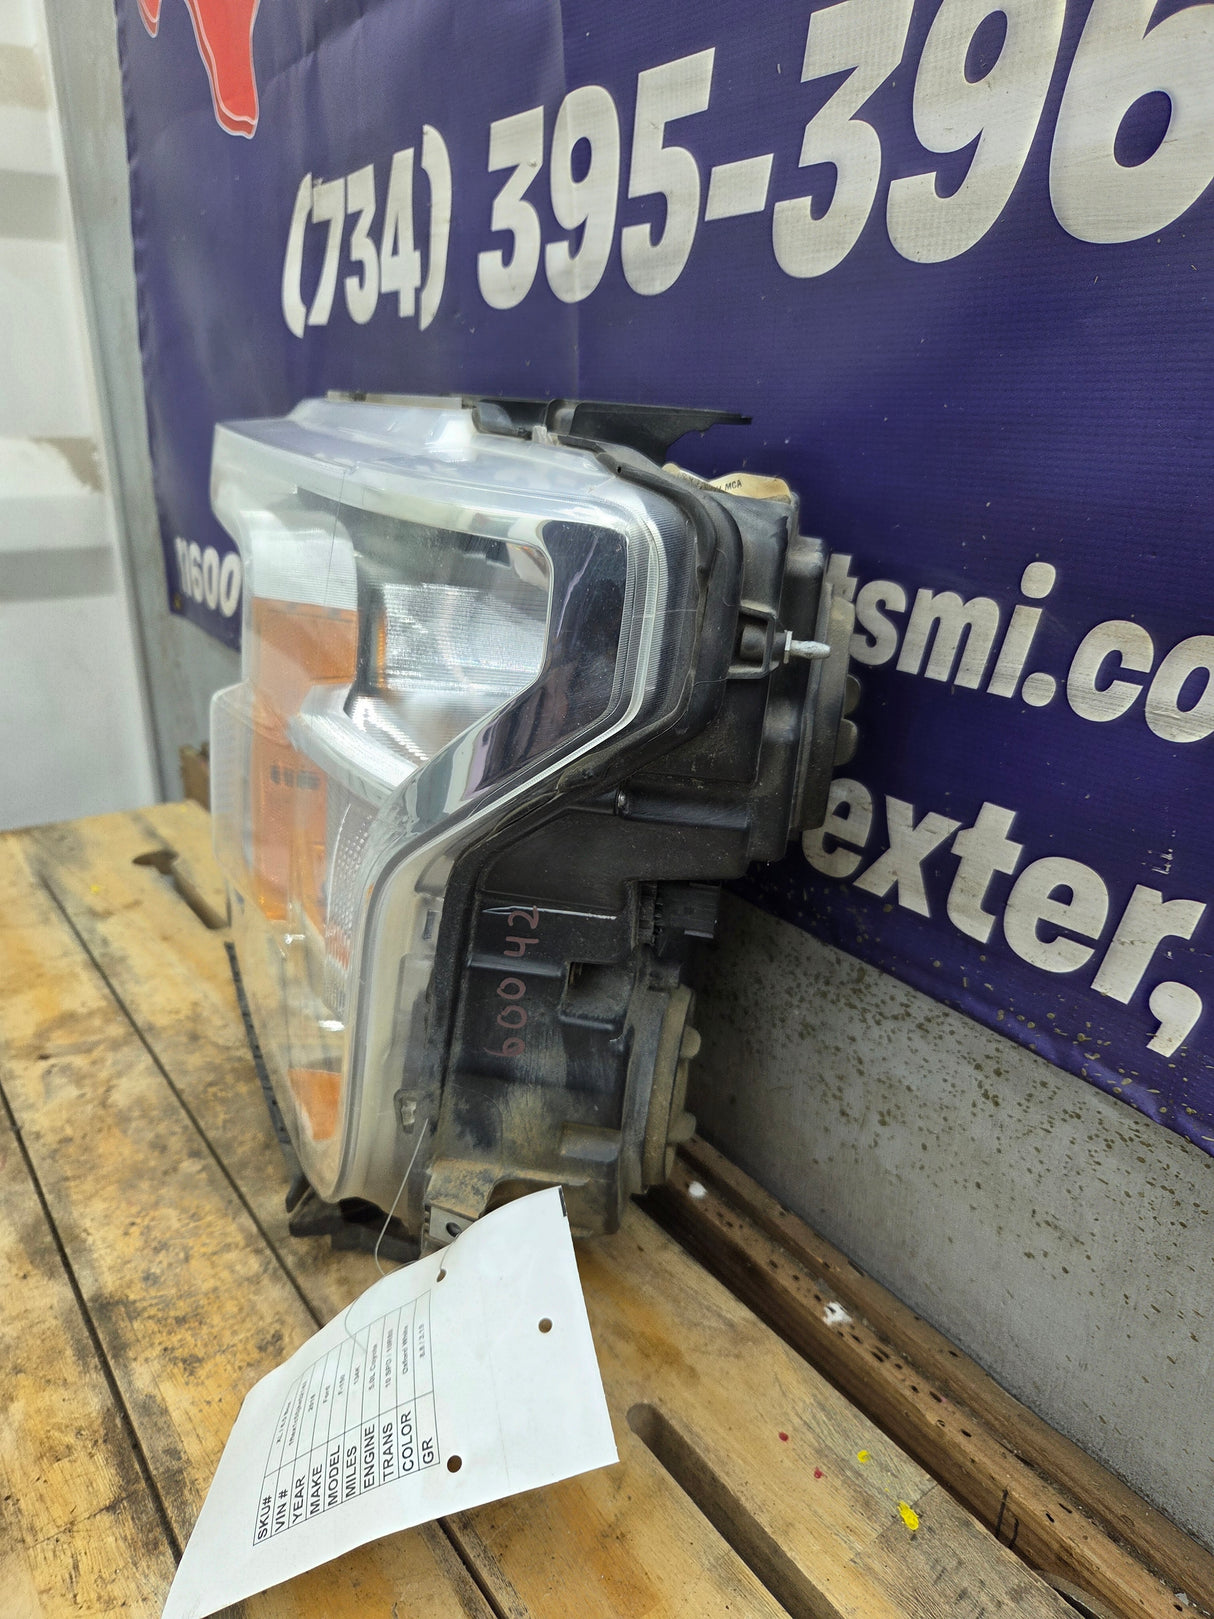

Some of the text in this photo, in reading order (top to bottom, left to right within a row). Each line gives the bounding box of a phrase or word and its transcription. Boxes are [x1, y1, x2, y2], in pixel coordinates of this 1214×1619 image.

[281, 124, 453, 339] (734)
[725, 479, 743, 491] MCA
[802, 777, 1207, 1058] exter,
[363, 1424, 375, 1489] ENGINE
[382, 1422, 394, 1482] TRANS
[400, 1410, 414, 1472] COLOR
[422, 1437, 434, 1465] GR
[310, 1464, 323, 1515] MAKE
[328, 1444, 341, 1507] MODEL
[345, 1446, 357, 1498] MILES
[258, 1495, 272, 1540] SKU#
[275, 1489, 289, 1532] VIN #
[292, 1475, 306, 1524] YEAR
